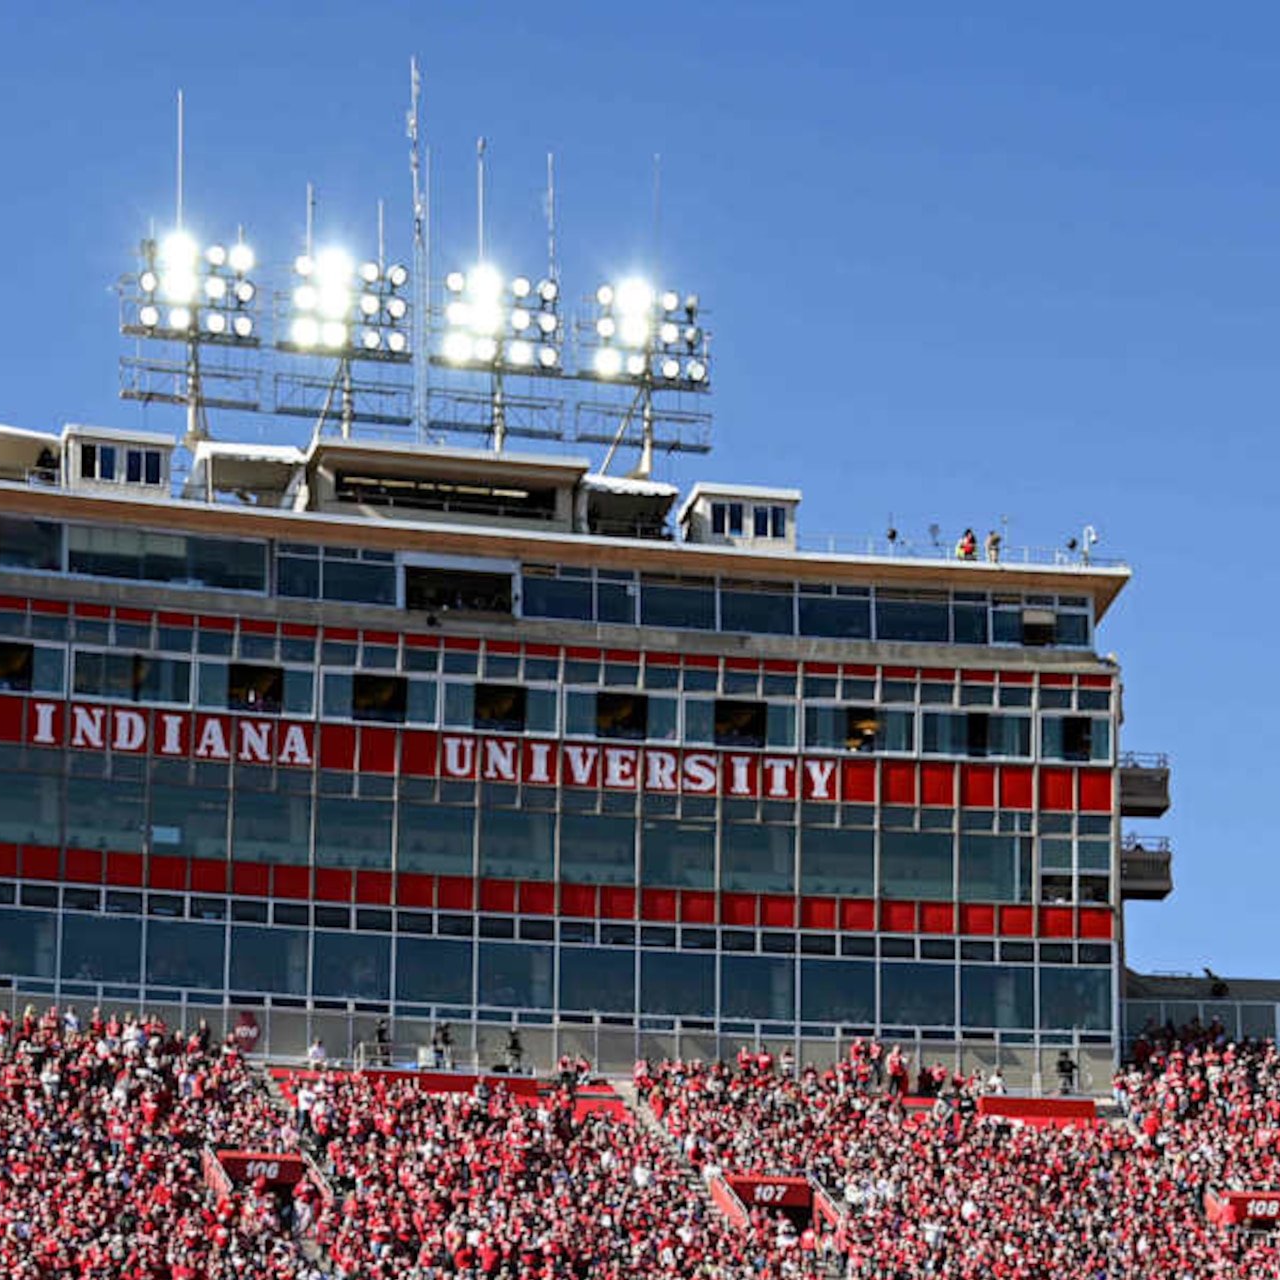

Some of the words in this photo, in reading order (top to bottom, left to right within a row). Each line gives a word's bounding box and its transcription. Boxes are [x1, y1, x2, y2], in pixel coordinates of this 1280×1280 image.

[32, 701, 313, 765] INDIANA
[443, 737, 838, 801] UNIVERSITY
[246, 1160, 280, 1180] 106
[753, 1184, 787, 1203] 107
[1246, 1199, 1280, 1217] 108
